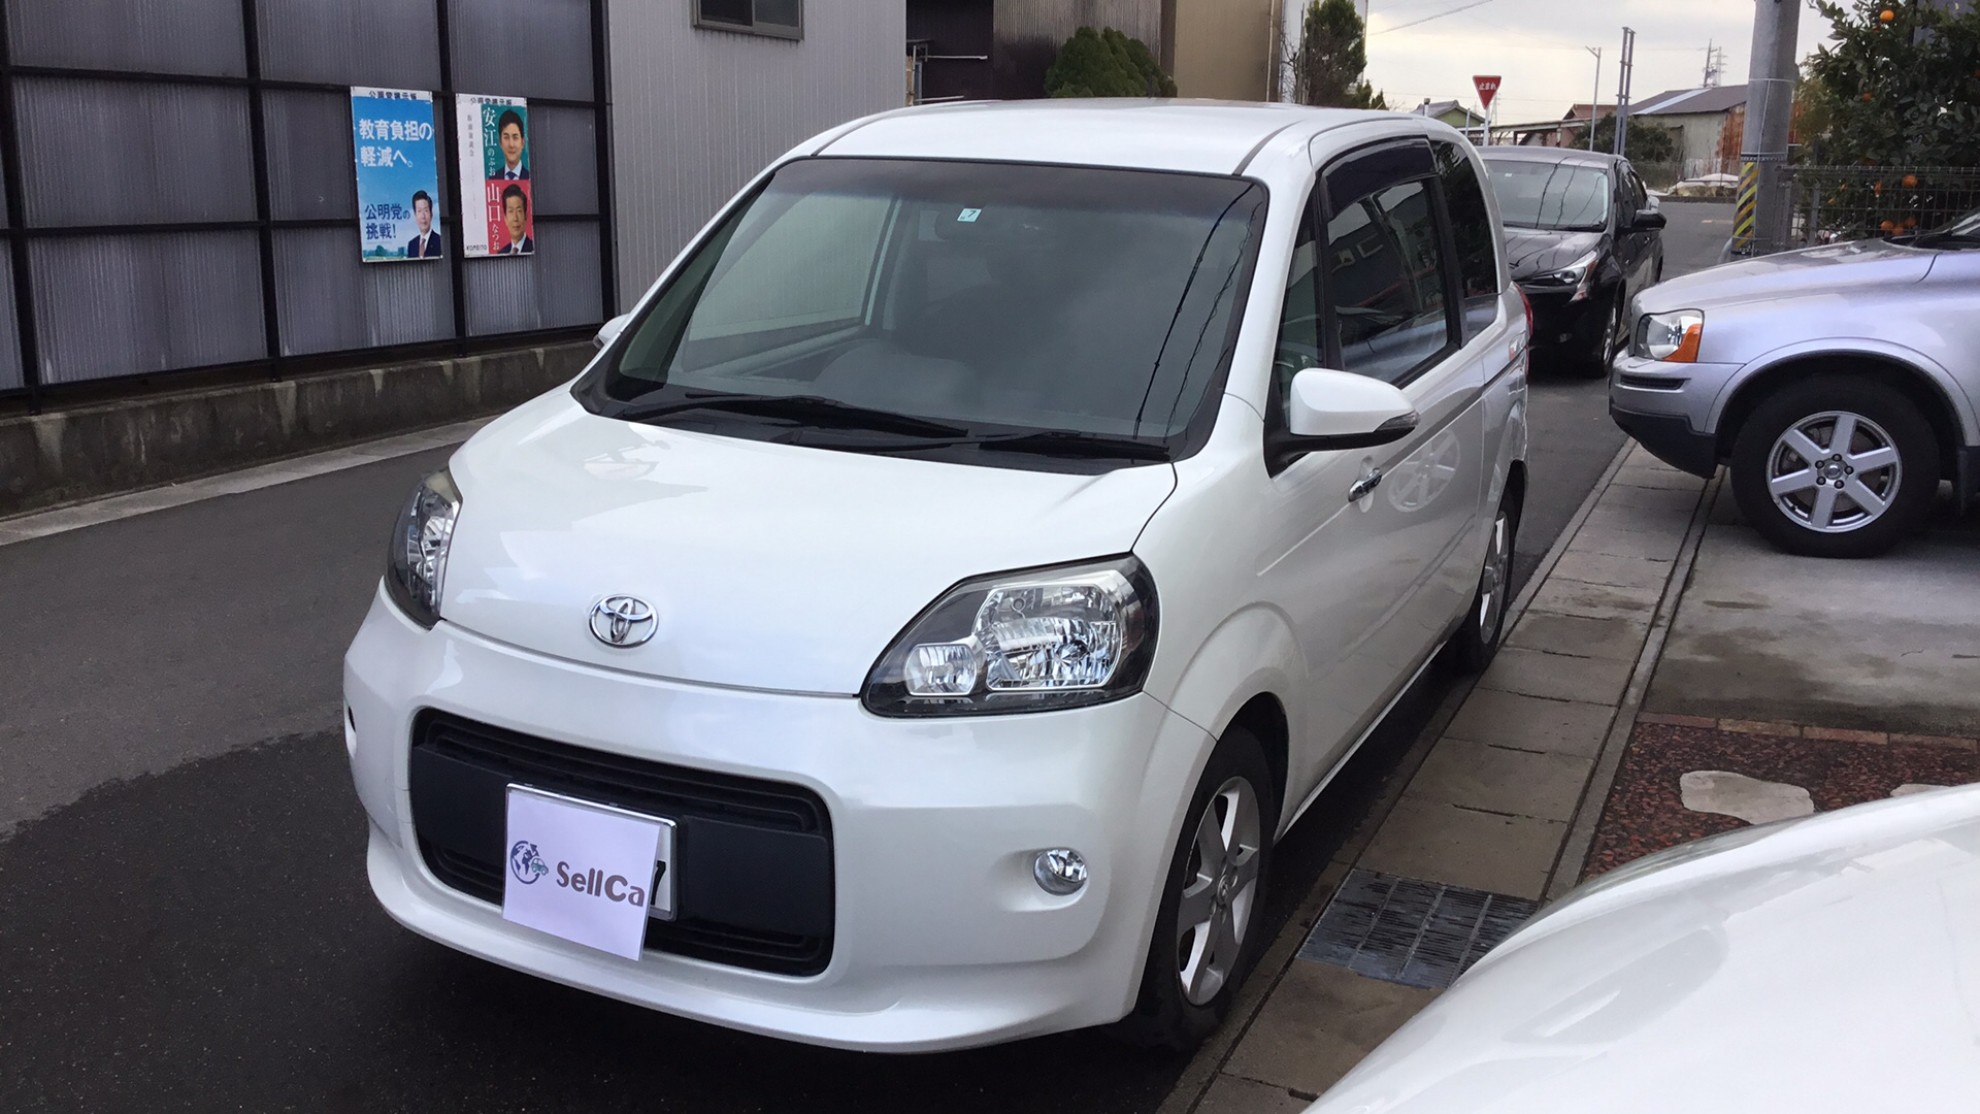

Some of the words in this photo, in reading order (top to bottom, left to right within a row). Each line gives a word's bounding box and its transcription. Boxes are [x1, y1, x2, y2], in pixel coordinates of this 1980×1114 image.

[358, 118, 433, 142] 教育負担の
[482, 107, 498, 176] 安江のぶお
[360, 146, 414, 168] 軽減へ。
[364, 203, 411, 221] 公明党の
[486, 183, 501, 251] 山口なつお
[556, 861, 645, 908] SellCa
